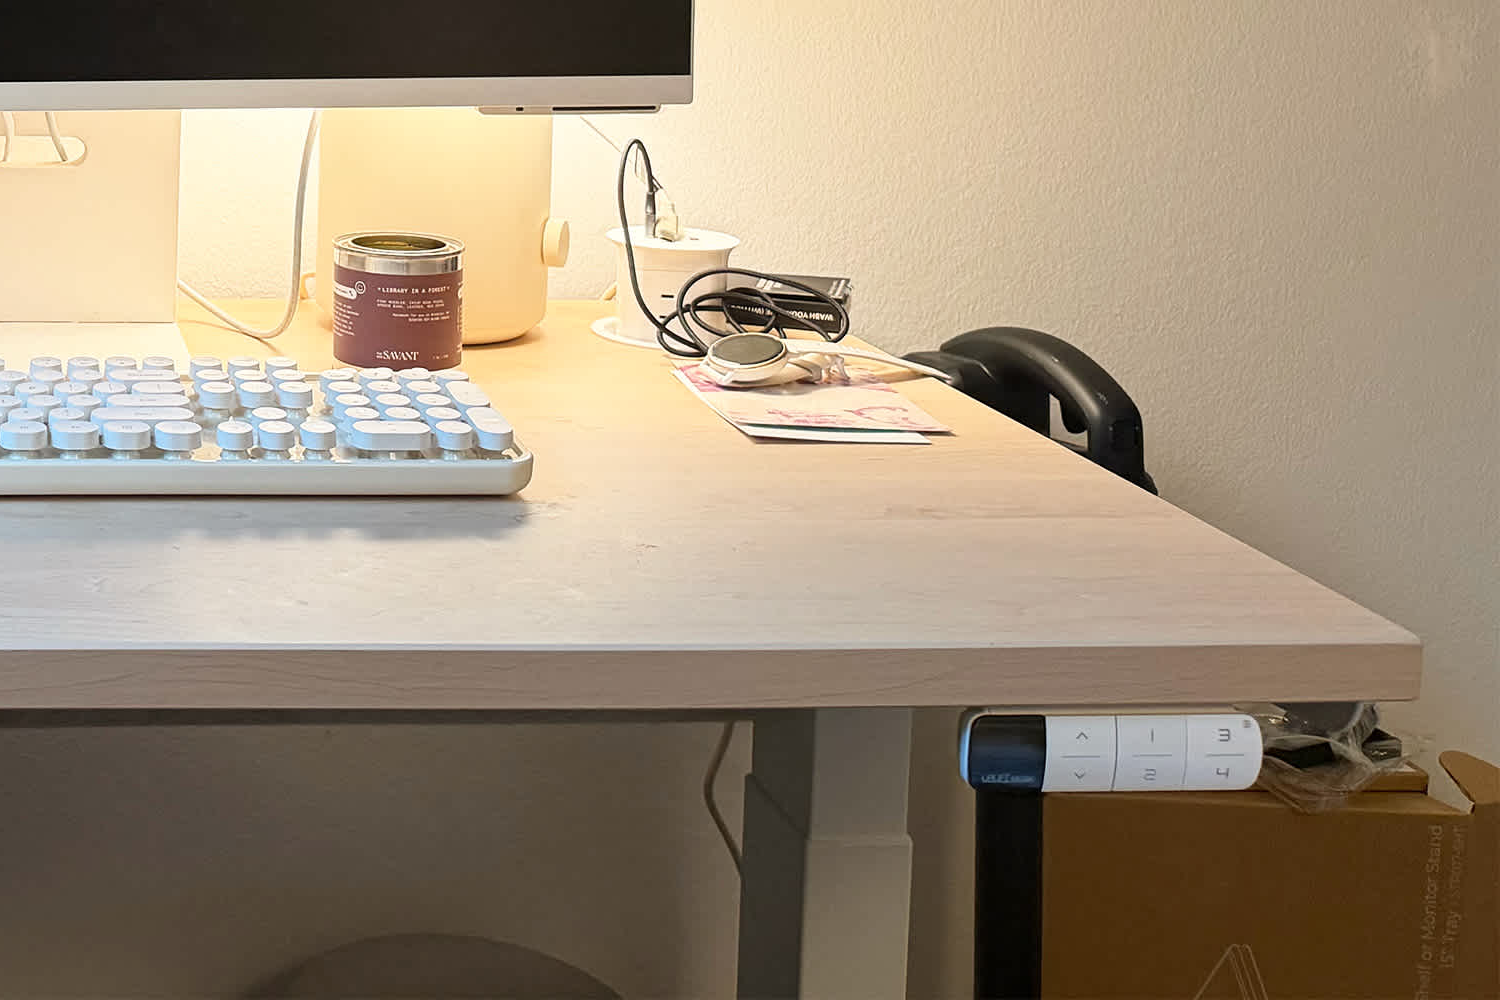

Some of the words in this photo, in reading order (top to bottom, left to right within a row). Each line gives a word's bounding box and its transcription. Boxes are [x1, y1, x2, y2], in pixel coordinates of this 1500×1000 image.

[383, 350, 419, 361] SAVANT
[1218, 728, 1231, 742] 3
[1143, 768, 1157, 781] 2
[1216, 767, 1230, 779] 4
[1426, 824, 1444, 873] Stand
[1421, 877, 1437, 941] Monitor
